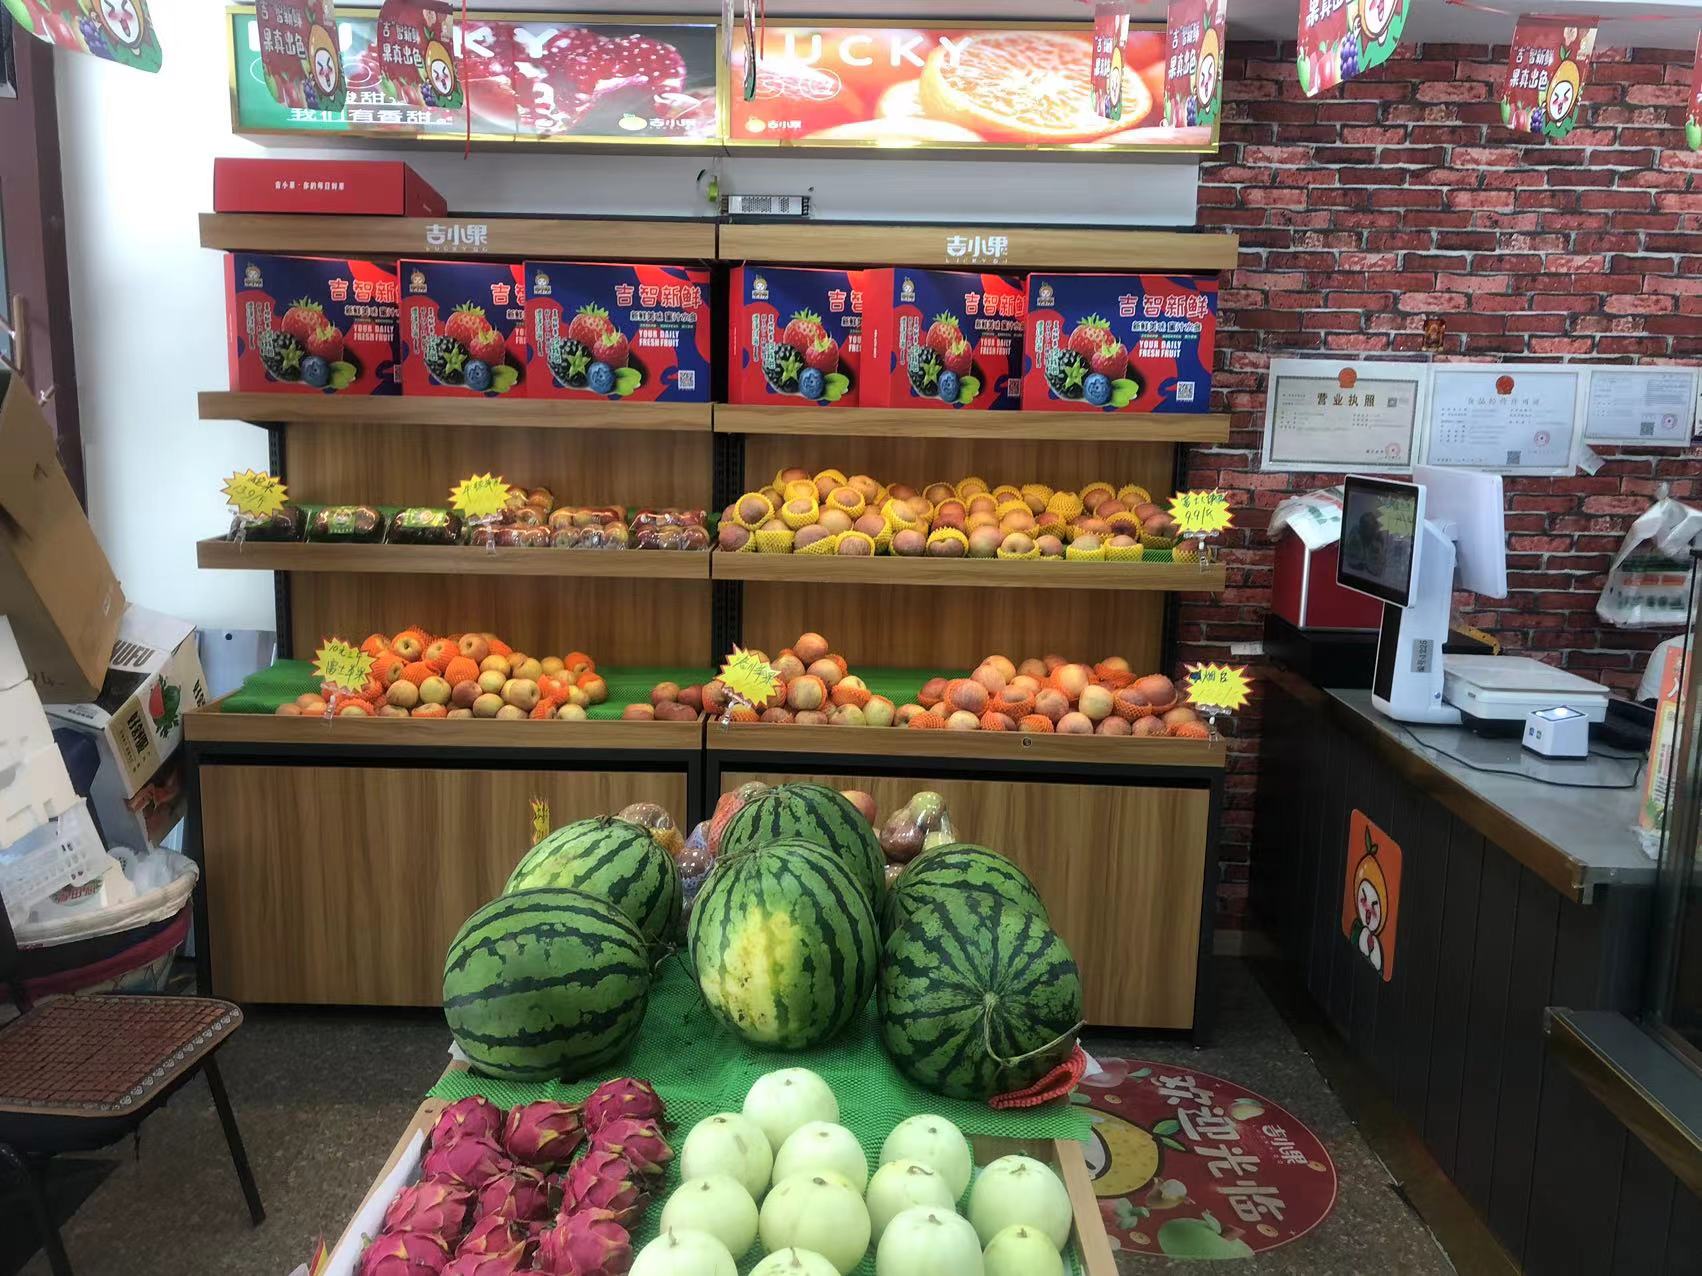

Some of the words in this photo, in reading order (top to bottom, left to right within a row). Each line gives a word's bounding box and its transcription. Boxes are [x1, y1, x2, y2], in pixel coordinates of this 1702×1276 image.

[264, 27, 306, 58] 果真出色
[382, 43, 424, 68] 果真出色
[1168, 49, 1197, 79] 果真出色
[1510, 68, 1549, 91] 果真出色
[425, 223, 488, 246] 吉小果
[946, 235, 1009, 257] 吉小果
[328, 278, 400, 303] 吉智新
[614, 283, 702, 309] 吉智新鲜
[1118, 293, 1209, 319] 吉智新鲜
[353, 324, 373, 333] YOUR
[375, 325, 395, 333] DAILY
[639, 330, 658, 339] YOUR
[660, 330, 680, 339] DAILY
[639, 339, 660, 347] FRESH
[660, 339, 680, 348] FRUIT
[1139, 340, 1159, 349] YOUR
[1161, 341, 1182, 349] DAILY
[1139, 349, 1160, 358] FRESH
[1160, 349, 1181, 358] FRUIT
[1317, 392, 1375, 407] 营业执照
[1150, 1074, 1287, 1222] 欢迎光临
[1261, 1124, 1309, 1165] 吉小果
